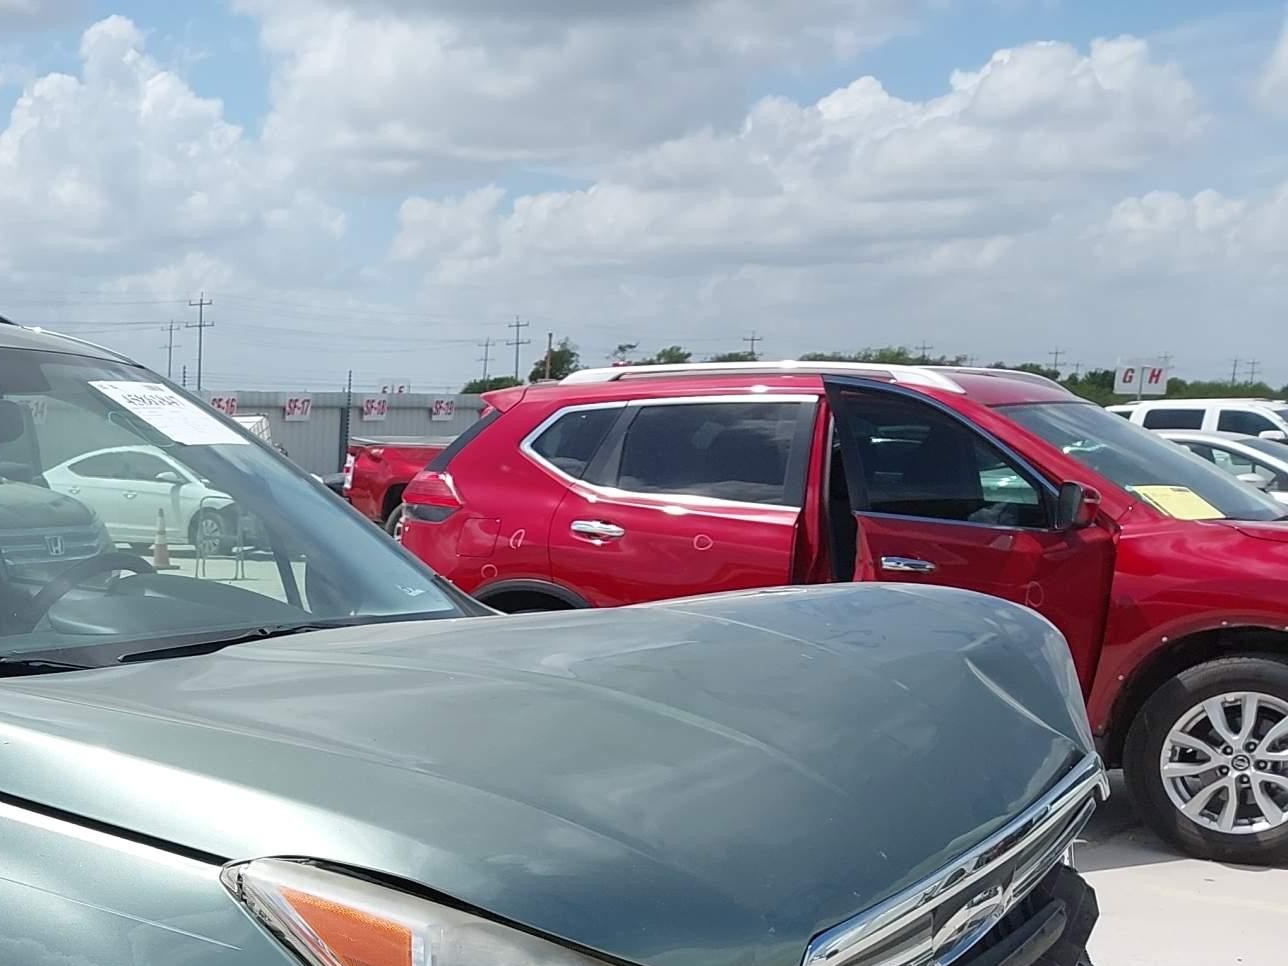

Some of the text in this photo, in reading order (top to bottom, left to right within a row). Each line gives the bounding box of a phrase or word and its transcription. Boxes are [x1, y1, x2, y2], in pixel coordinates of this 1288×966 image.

[1122, 367, 1163, 384] G H
[286, 398, 311, 416] SF-17
